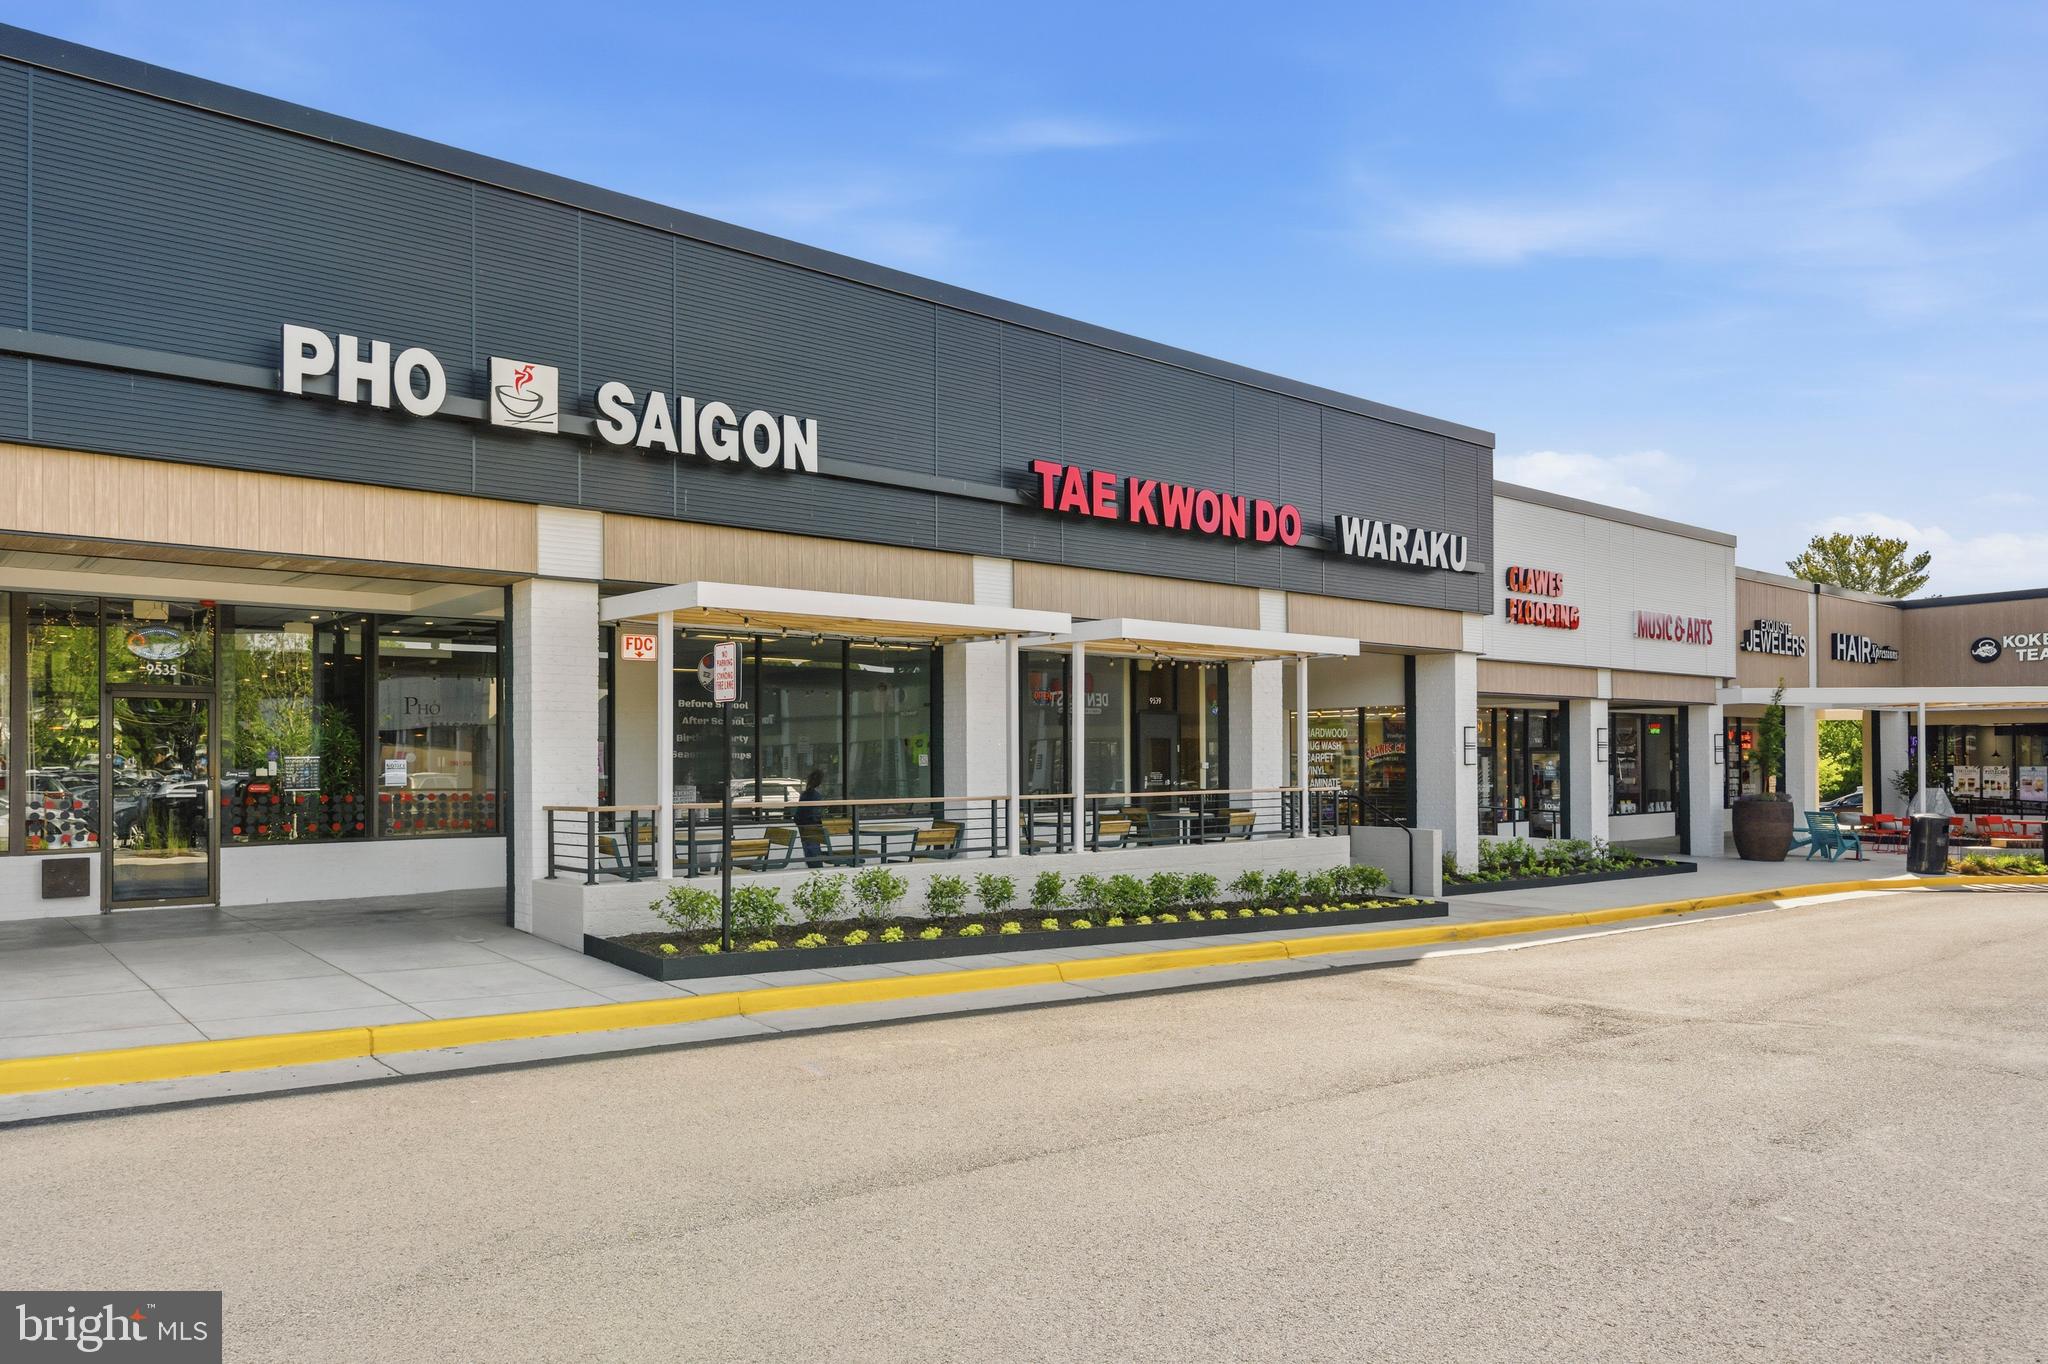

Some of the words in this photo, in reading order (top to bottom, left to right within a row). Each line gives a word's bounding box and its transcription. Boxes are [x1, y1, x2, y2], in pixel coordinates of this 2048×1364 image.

[281, 324, 446, 417] PHO
[594, 381, 818, 473] SAIGON
[1030, 459, 1119, 520] TAE
[1125, 476, 1246, 539] KWON
[1252, 499, 1302, 547] DO
[1335, 515, 1468, 572] WARAKU
[1506, 565, 1563, 597] CLAWES
[1506, 598, 1580, 630] FLOORING
[1636, 610, 1672, 641] MUSIC
[1675, 615, 1685, 642] &
[1687, 616, 1713, 645] ARTS
[1758, 619, 1792, 635] EXQUISITE
[625, 637, 653, 650] FDC
[1745, 629, 1806, 657] JEWELERS
[1834, 633, 1871, 664] HAIR
[2016, 648, 2048, 661] TEA
[146, 664, 177, 676] 9535
[678, 700, 713, 709] Before
[682, 717, 709, 725] After
[711, 717, 744, 726] Scol
[1308, 728, 1348, 738] ARDWOOD
[1310, 741, 1320, 751] UG
[1321, 741, 1341, 750] WASH
[1309, 778, 1341, 788] AMINATE
